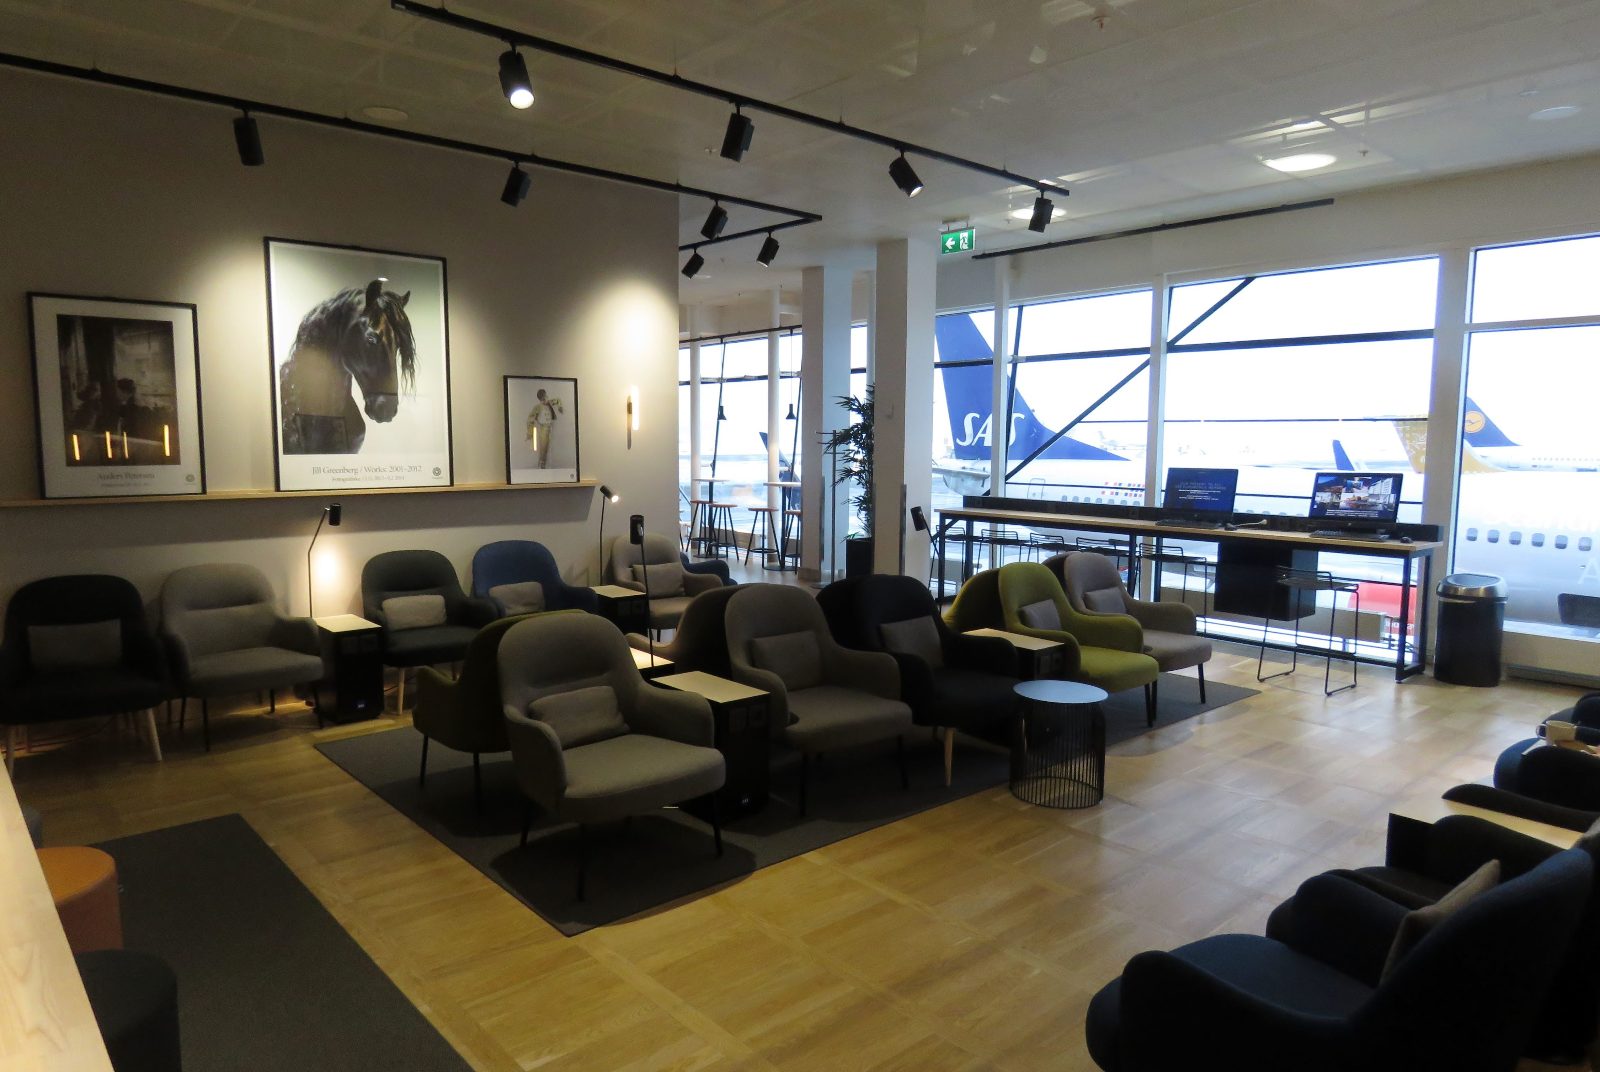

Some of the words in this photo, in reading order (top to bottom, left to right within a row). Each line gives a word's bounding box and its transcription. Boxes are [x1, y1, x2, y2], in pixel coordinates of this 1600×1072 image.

[956, 412, 1025, 447] SAS
[312, 466, 321, 475] Jill
[322, 465, 359, 475] Greenberg
